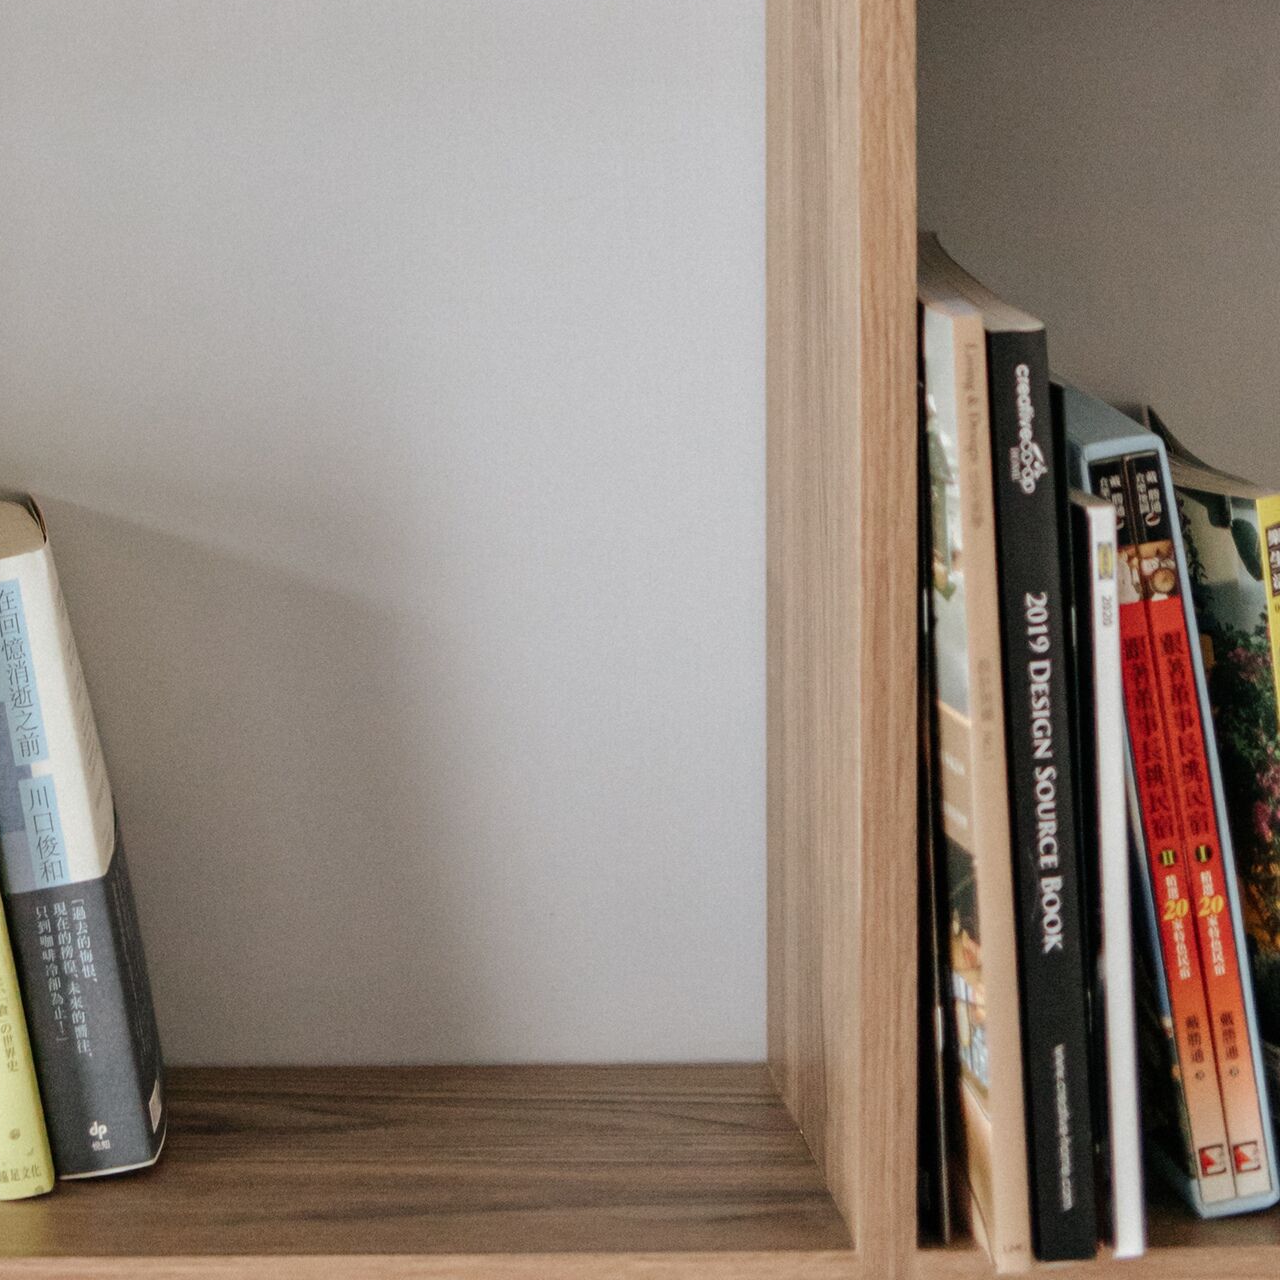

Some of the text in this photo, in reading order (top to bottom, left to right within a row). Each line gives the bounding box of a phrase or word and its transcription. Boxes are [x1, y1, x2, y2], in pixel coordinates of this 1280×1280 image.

[1024, 591, 1063, 954] 2019 DESIGN SOURCE BOOK
[28, 785, 65, 883] 川口俊和
[88, 1120, 108, 1140] dp
